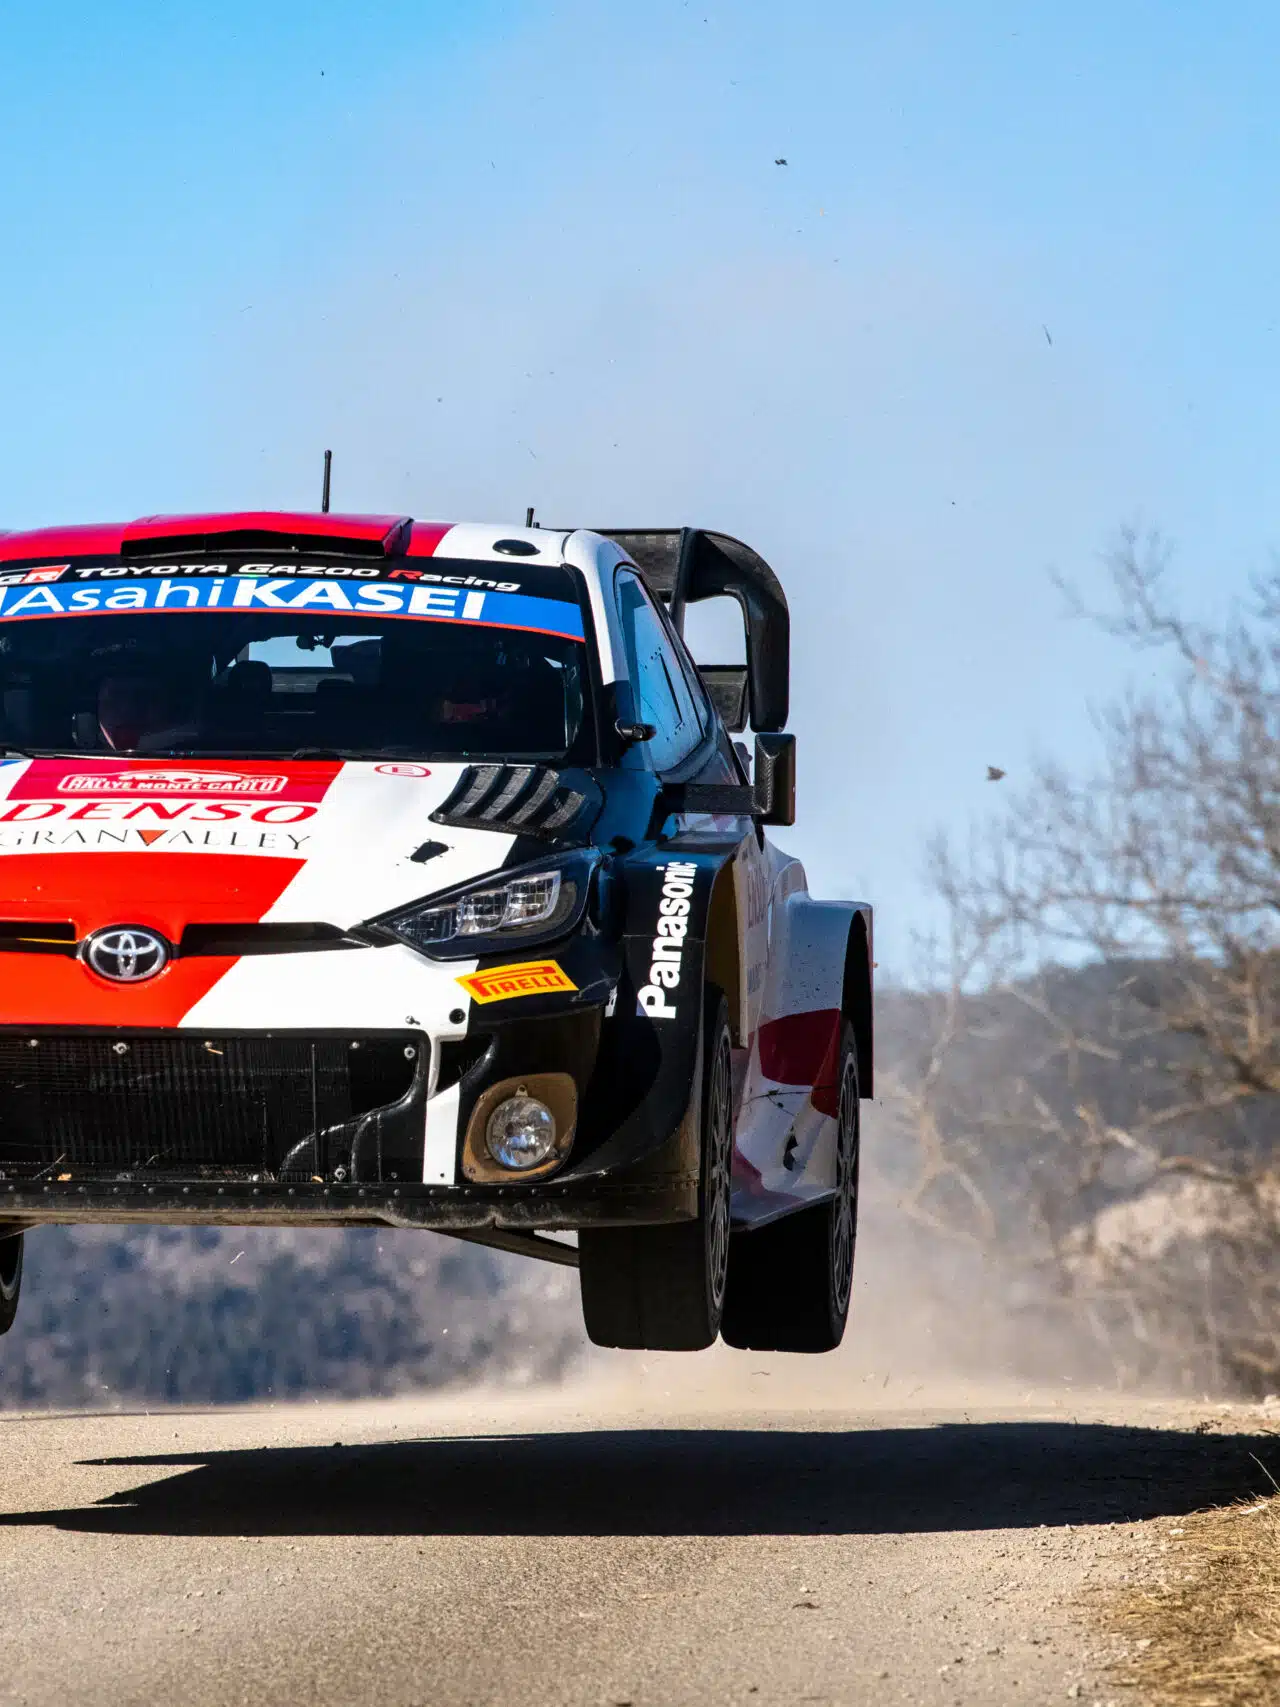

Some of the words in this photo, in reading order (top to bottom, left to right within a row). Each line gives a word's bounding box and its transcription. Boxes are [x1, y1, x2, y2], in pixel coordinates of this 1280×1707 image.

[75, 564, 228, 578] TOYOTA
[238, 563, 380, 577] GAZOO
[388, 569, 521, 592] Racing
[636, 861, 698, 1019] Panasonic
[466, 966, 568, 998] PIRELLI
